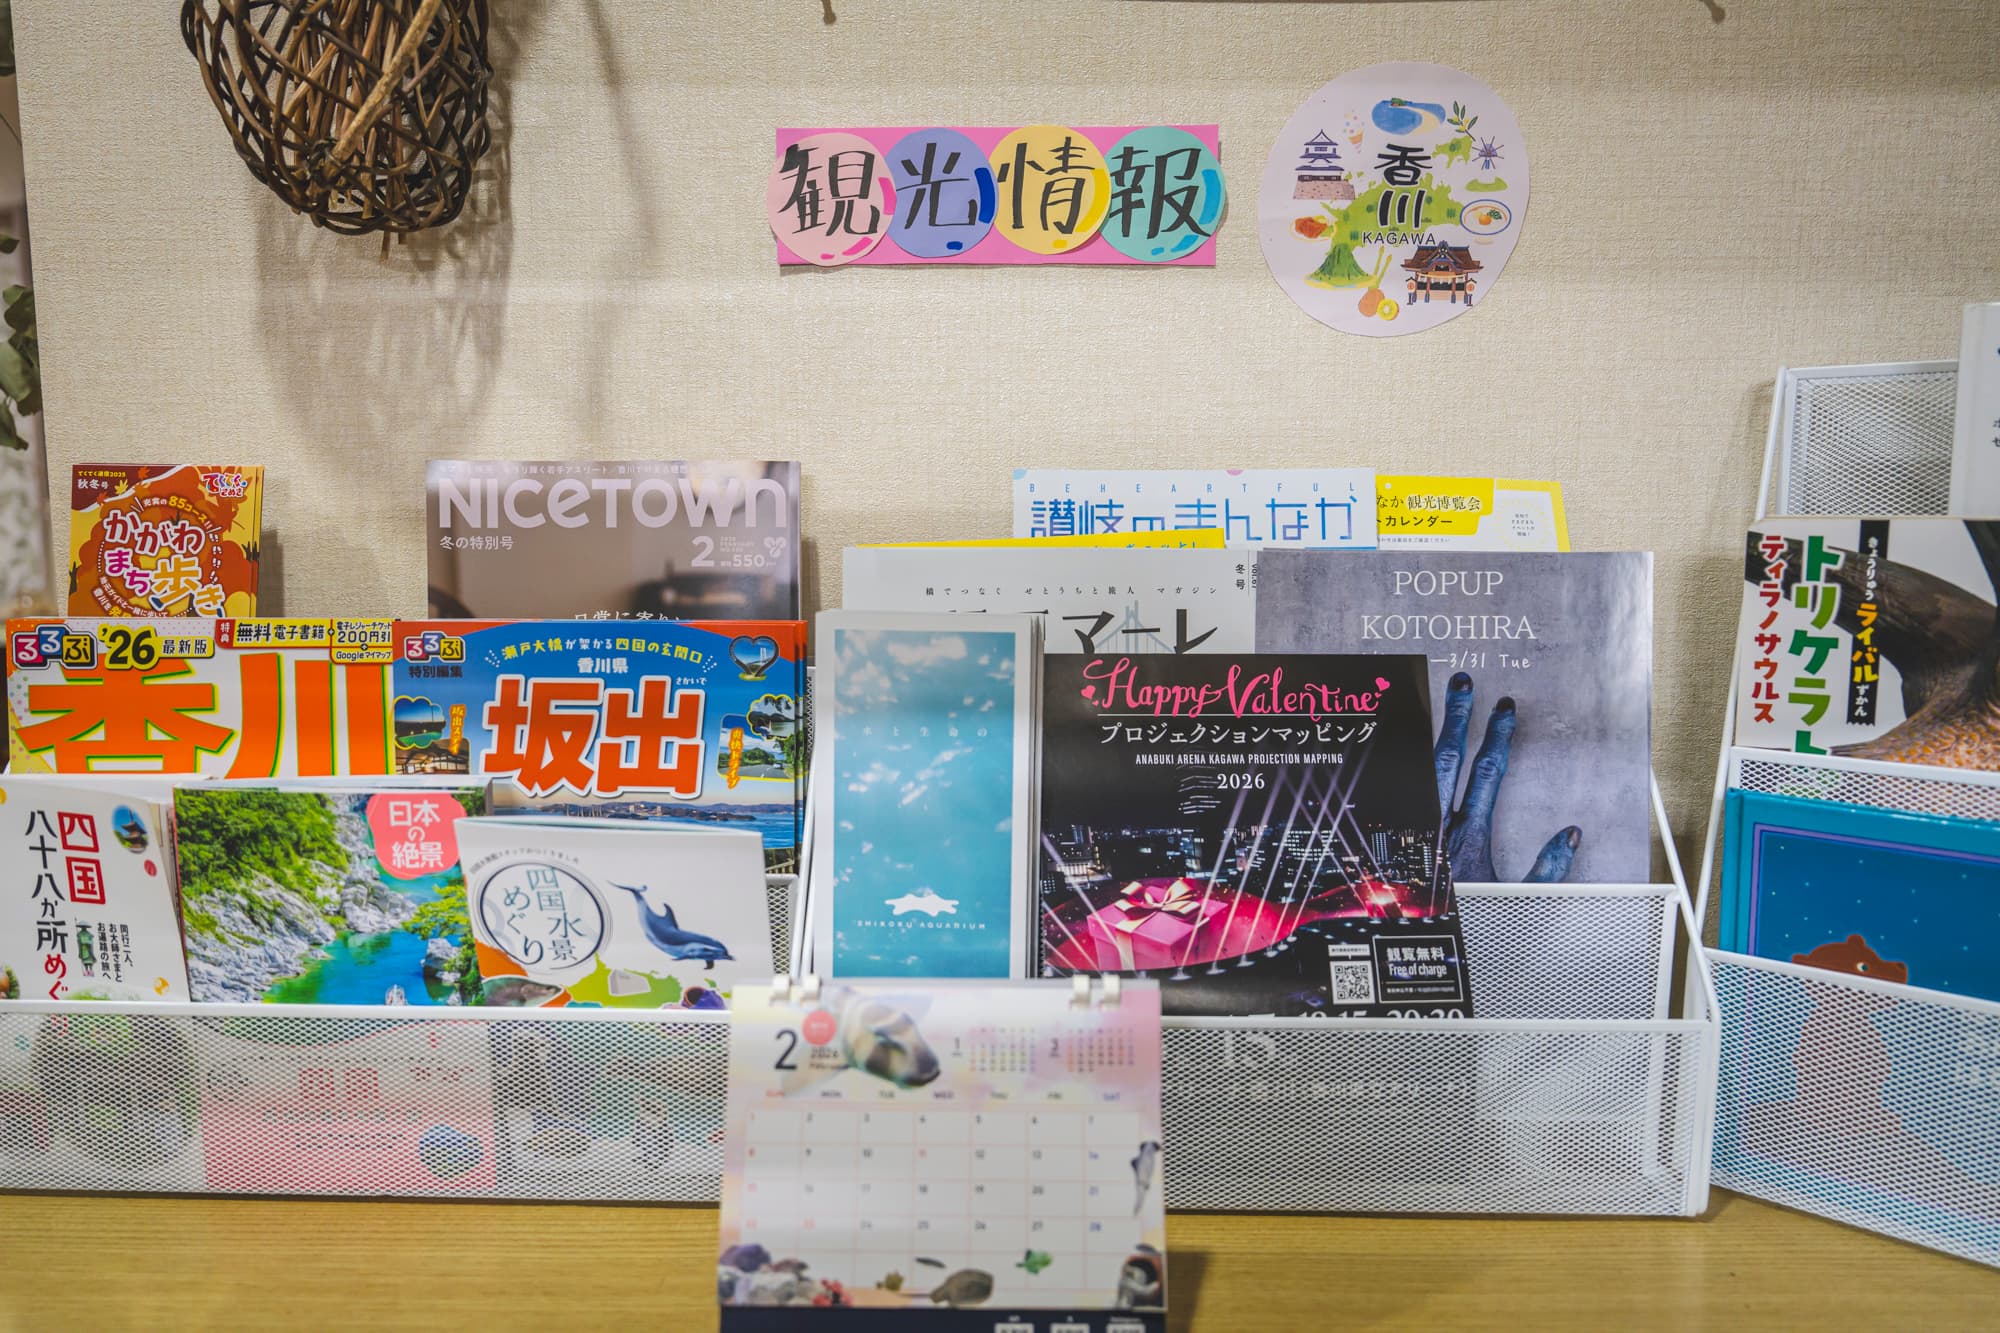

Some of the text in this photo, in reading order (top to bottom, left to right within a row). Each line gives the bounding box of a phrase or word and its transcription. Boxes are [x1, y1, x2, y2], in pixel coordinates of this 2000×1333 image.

[777, 136, 1211, 238] 観光情報
[1374, 143, 1433, 229] 香川
[1362, 232, 1436, 246] KAGAWA
[78, 479, 108, 489] 秋冬号
[1376, 516, 1453, 527] カレンダー
[105, 511, 205, 555] かがわ
[439, 535, 514, 550] 冬の特別号
[691, 535, 715, 567] 2
[733, 554, 765, 568] 550
[1393, 570, 1504, 596] POPUP
[1361, 614, 1537, 640] KOTOHIRA
[1751, 534, 1785, 724] ティラノサウルス
[14, 627, 93, 666] るるぶ
[162, 639, 208, 656] 最新版
[337, 631, 391, 644] 200円引
[405, 632, 463, 660] るるぶ
[336, 651, 392, 662] Googleマイマップ
[577, 657, 629, 674] 香川県
[1499, 653, 1531, 669] Tue
[408, 665, 463, 679] 特別編集
[1083, 657, 1380, 722] Happy Valentine
[15, 652, 388, 779] 香川
[481, 676, 705, 797] 坂出
[1100, 721, 1378, 745] プロジェクションマッピング
[1136, 752, 1344, 765] ANABUKI ARENA KAGAWA PROJECTION MAPPING
[1217, 773, 1265, 790] 2026
[388, 800, 441, 828] 日本
[408, 827, 426, 842] の
[57, 811, 106, 905] 四国
[391, 841, 444, 869] 絶景
[919, 922, 986, 930] AQUARIUM
[1386, 946, 1446, 962] 観覧無料
[1388, 963, 1448, 978] Free of charge
[774, 1029, 798, 1070] 2
